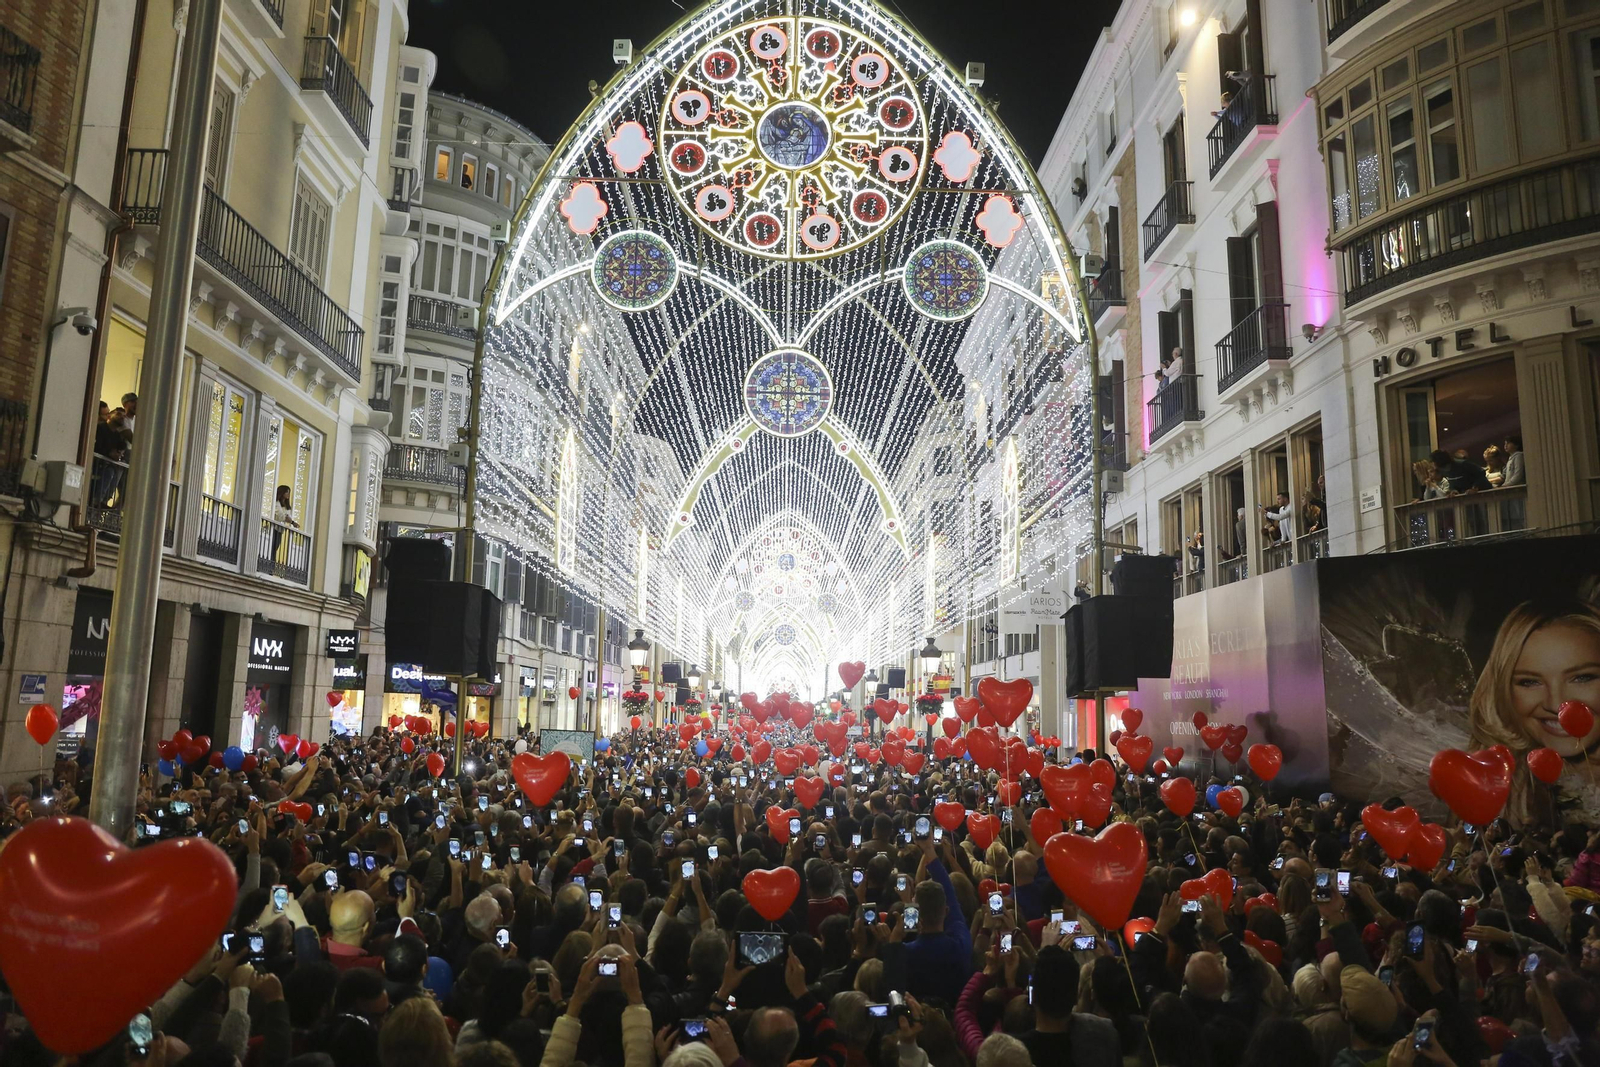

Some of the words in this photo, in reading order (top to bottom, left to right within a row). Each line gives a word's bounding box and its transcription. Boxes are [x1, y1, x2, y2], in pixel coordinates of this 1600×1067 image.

[1373, 322, 1510, 378] HOTEL
[1030, 597, 1062, 607] LARIOS
[330, 636, 355, 645] NYX
[253, 637, 284, 658] NYX
[1184, 689, 1203, 699] LONDON
